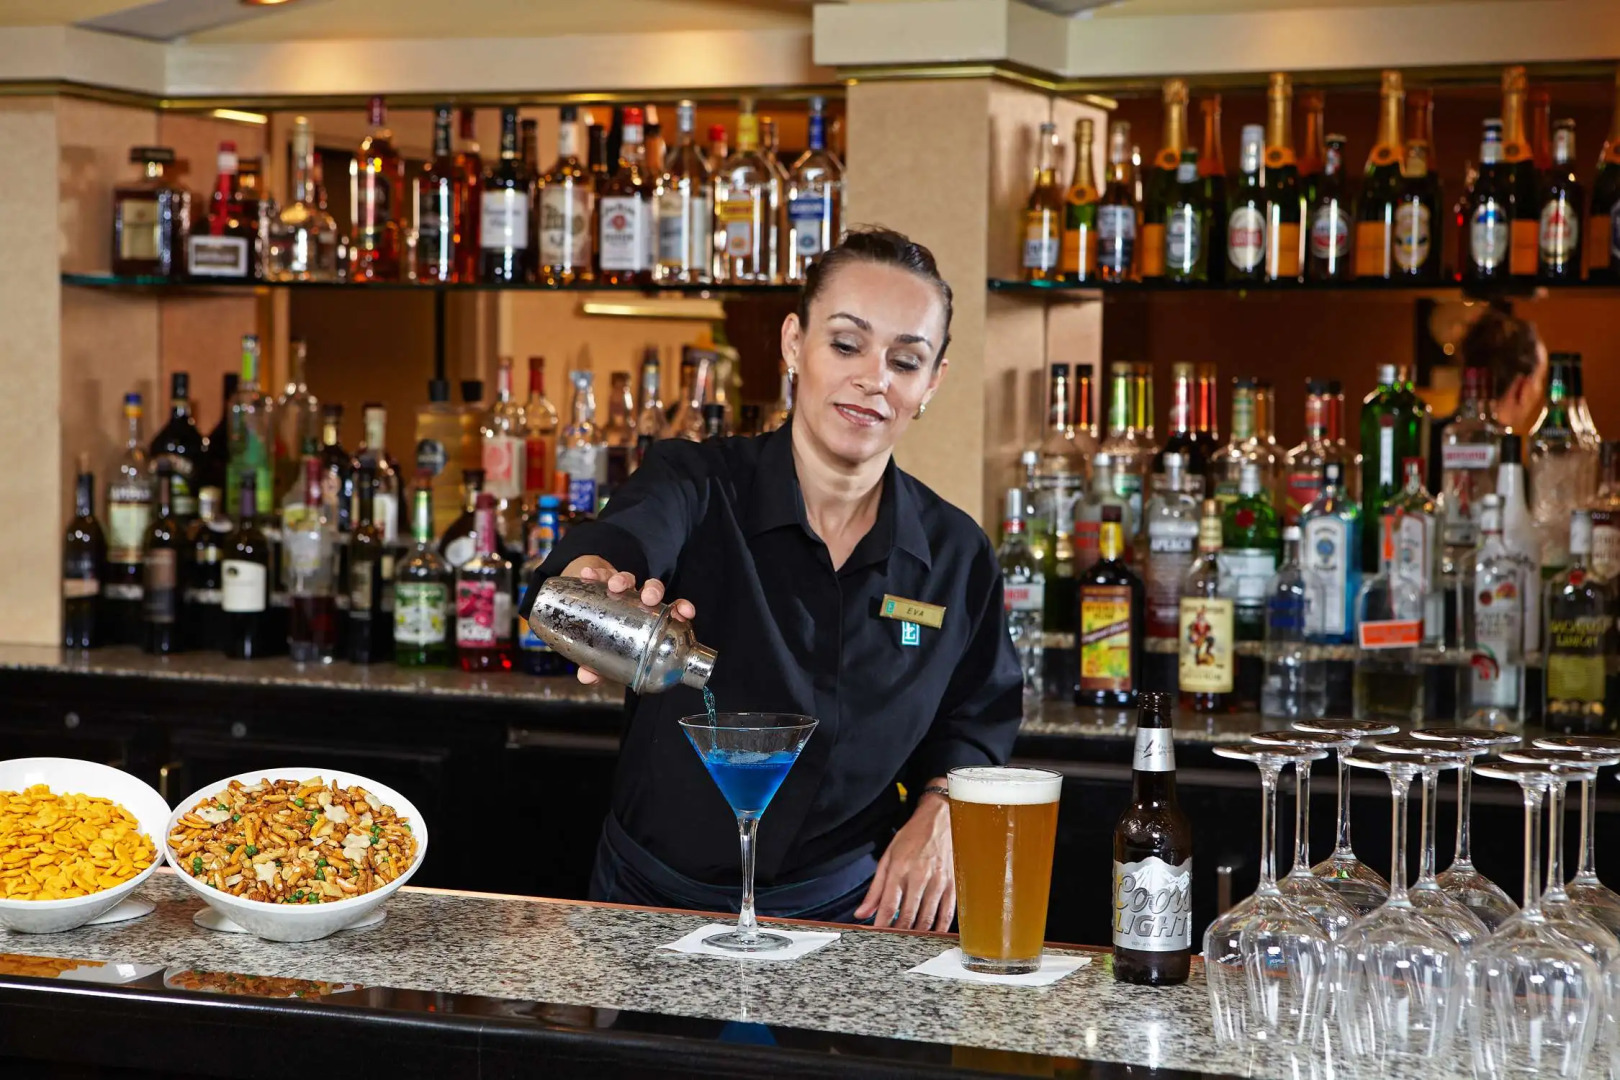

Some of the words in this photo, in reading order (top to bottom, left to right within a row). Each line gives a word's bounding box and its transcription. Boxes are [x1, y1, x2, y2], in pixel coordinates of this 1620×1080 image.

[906, 606, 925, 617] EVA
[1115, 872, 1192, 915] Coors
[1115, 910, 1188, 937] LIGHT
